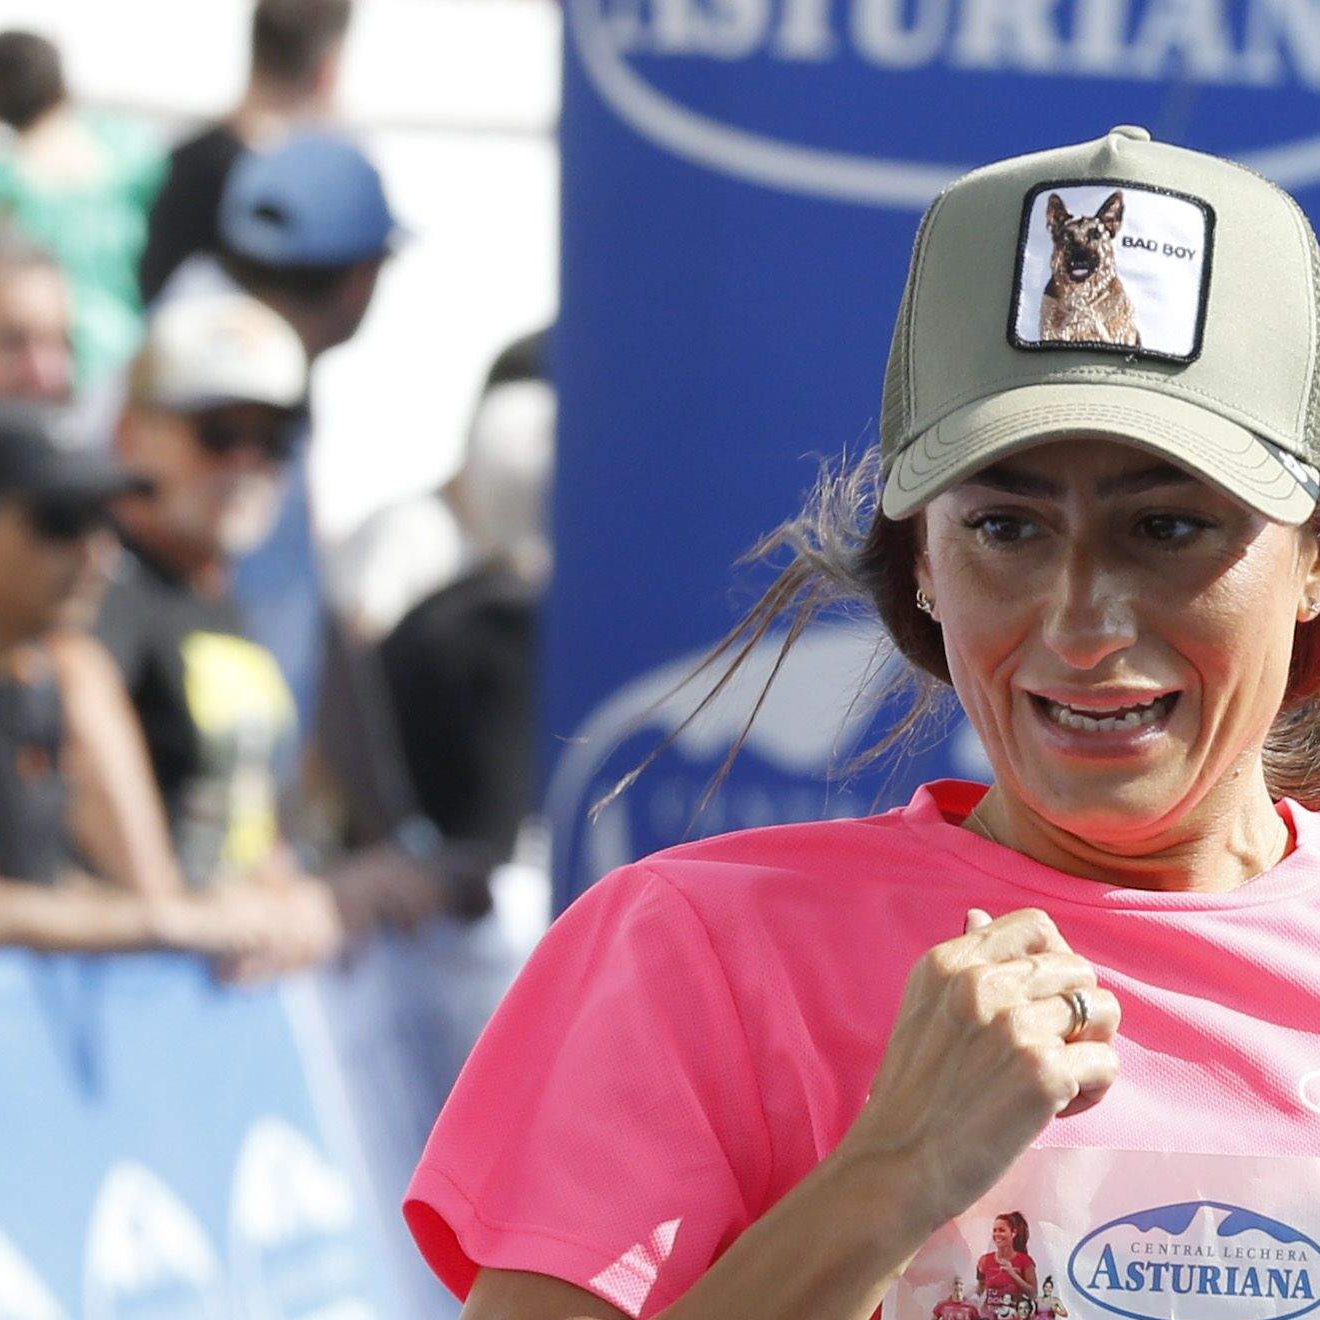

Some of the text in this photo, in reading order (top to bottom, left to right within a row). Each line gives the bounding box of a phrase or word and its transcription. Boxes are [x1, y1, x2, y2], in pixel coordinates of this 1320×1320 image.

[1122, 236, 1197, 261] BAD BOY
[1130, 1241, 1309, 1263] CENTRAL LECHERA
[1087, 1242, 1315, 1300] ASTURIANA
